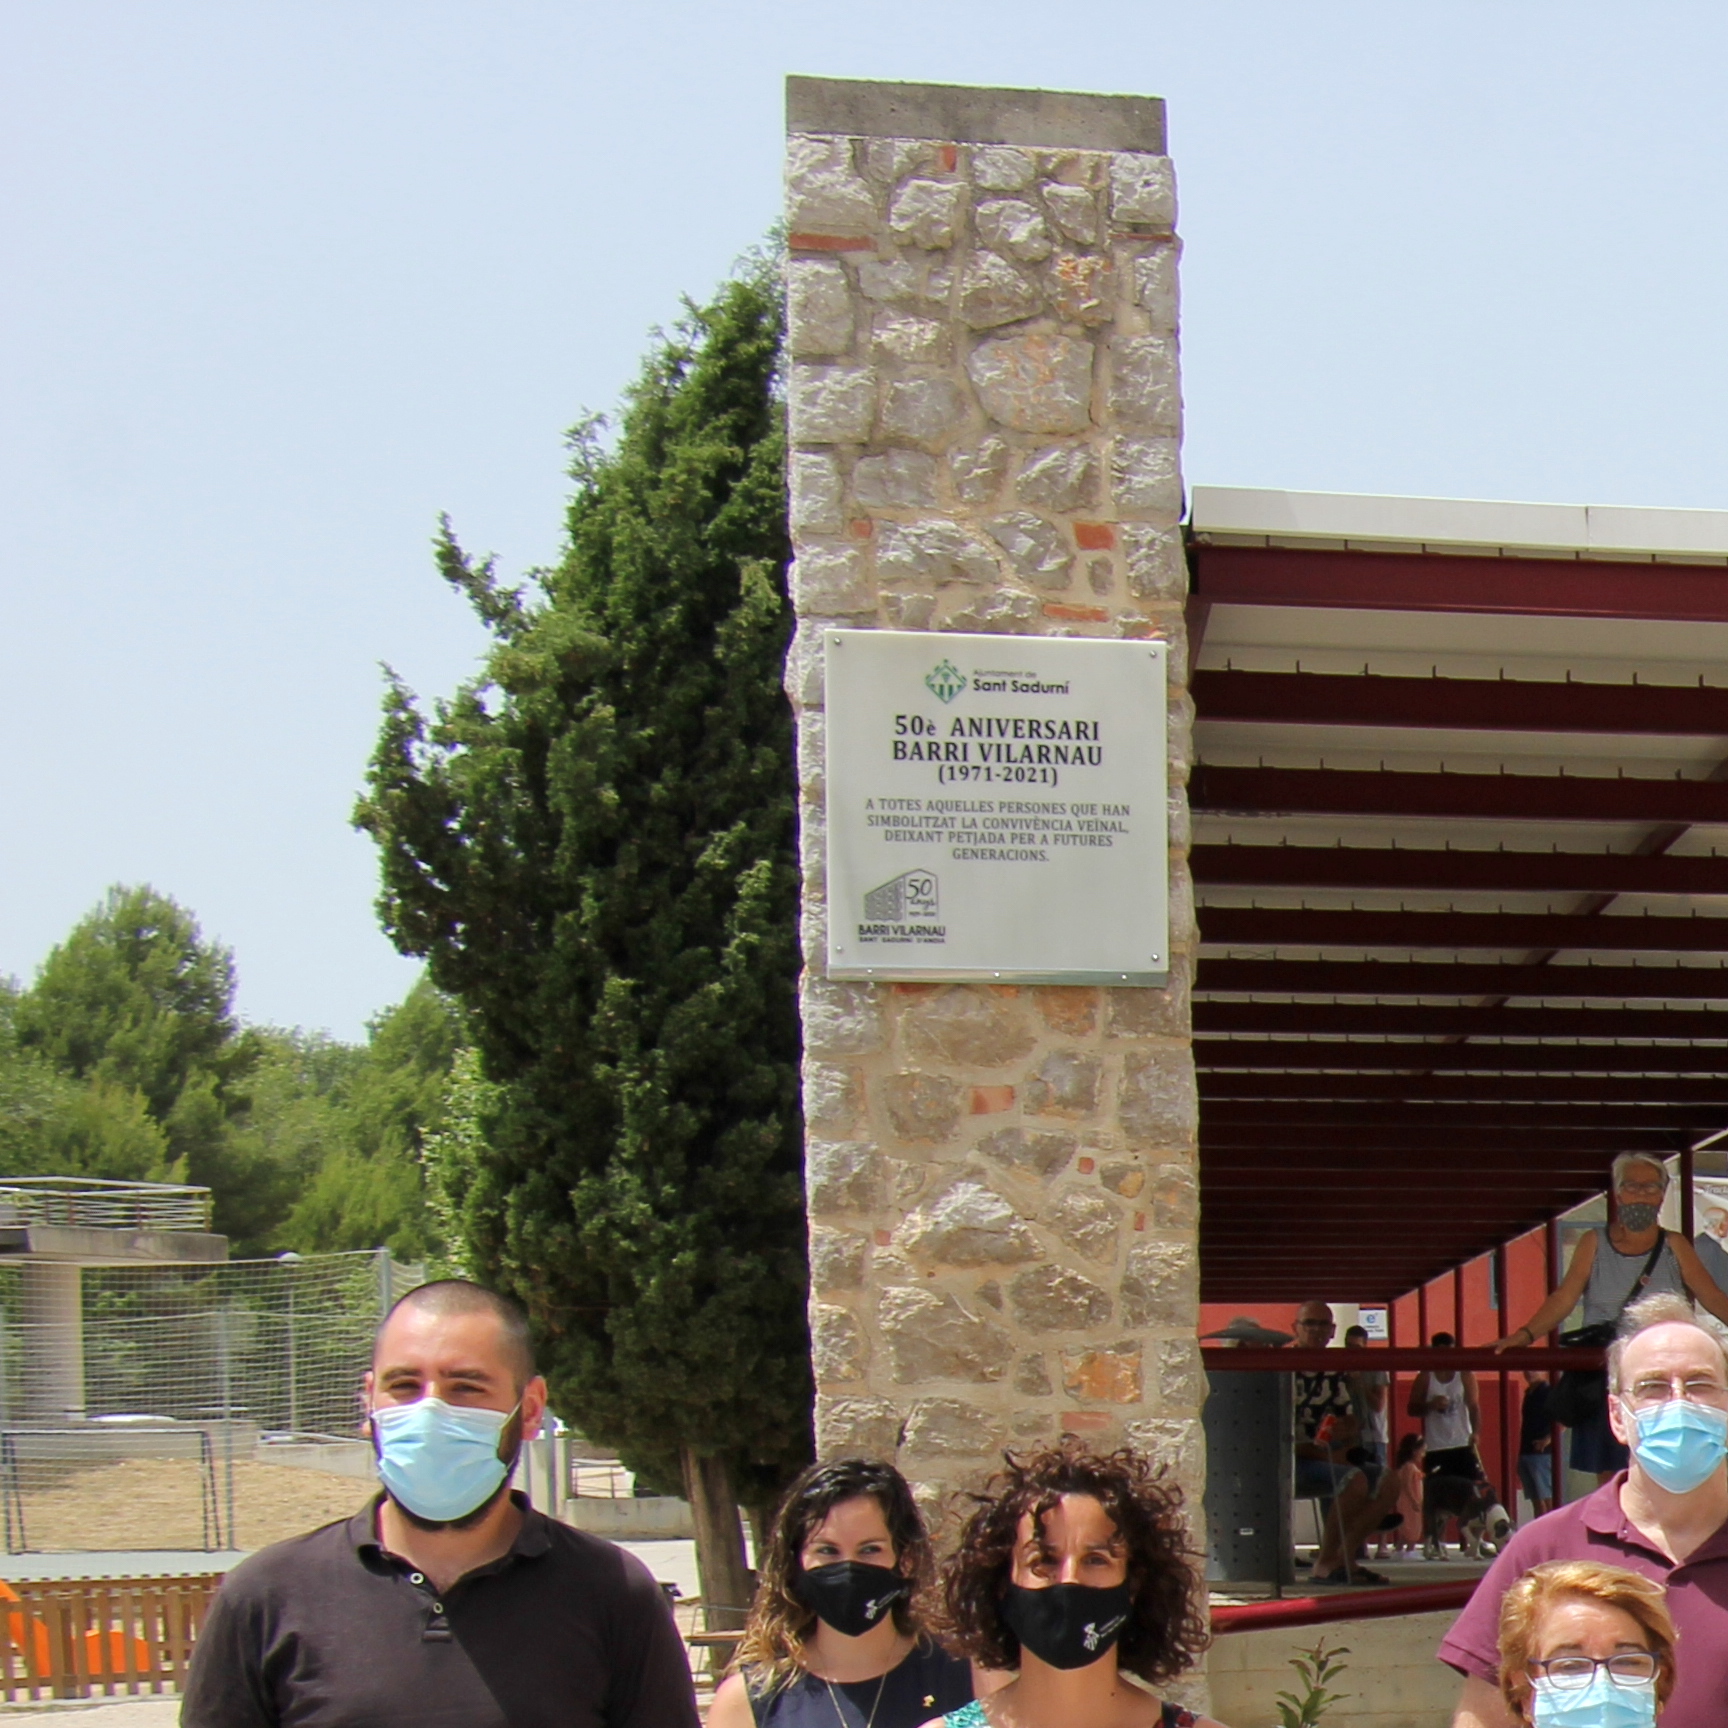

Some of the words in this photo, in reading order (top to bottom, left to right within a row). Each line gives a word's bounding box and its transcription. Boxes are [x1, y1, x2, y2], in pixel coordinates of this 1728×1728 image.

[973, 679, 1006, 692] Sant
[1011, 680, 1069, 694] Sadurní
[894, 714, 937, 736] 50è
[950, 717, 1100, 741] ANIVERSARI
[892, 740, 969, 762] BARRI
[977, 742, 1103, 766] VILARNAU
[938, 764, 1058, 787] (1971-2021)
[865, 798, 874, 810] A
[879, 798, 922, 811] TOTES
[926, 800, 994, 814] AQUELLES
[999, 801, 1067, 815] PERSONES
[1071, 803, 1098, 818] QUE
[1102, 804, 1131, 816] HAN
[867, 815, 957, 829] SIMBOLITZAT
[961, 817, 978, 829] LA
[982, 815, 1073, 831] CONVIVÈNCIA
[884, 829, 943, 842] DEIXANT
[948, 831, 1006, 845] PETJADA
[1010, 832, 1036, 845] PER
[1040, 834, 1049, 845] A
[1053, 833, 1113, 847] FUTURES
[952, 848, 1050, 862] GENERACIONS.
[905, 878, 932, 899] 50
[858, 924, 889, 935] BARRI
[892, 925, 946, 936] VILARNAU
